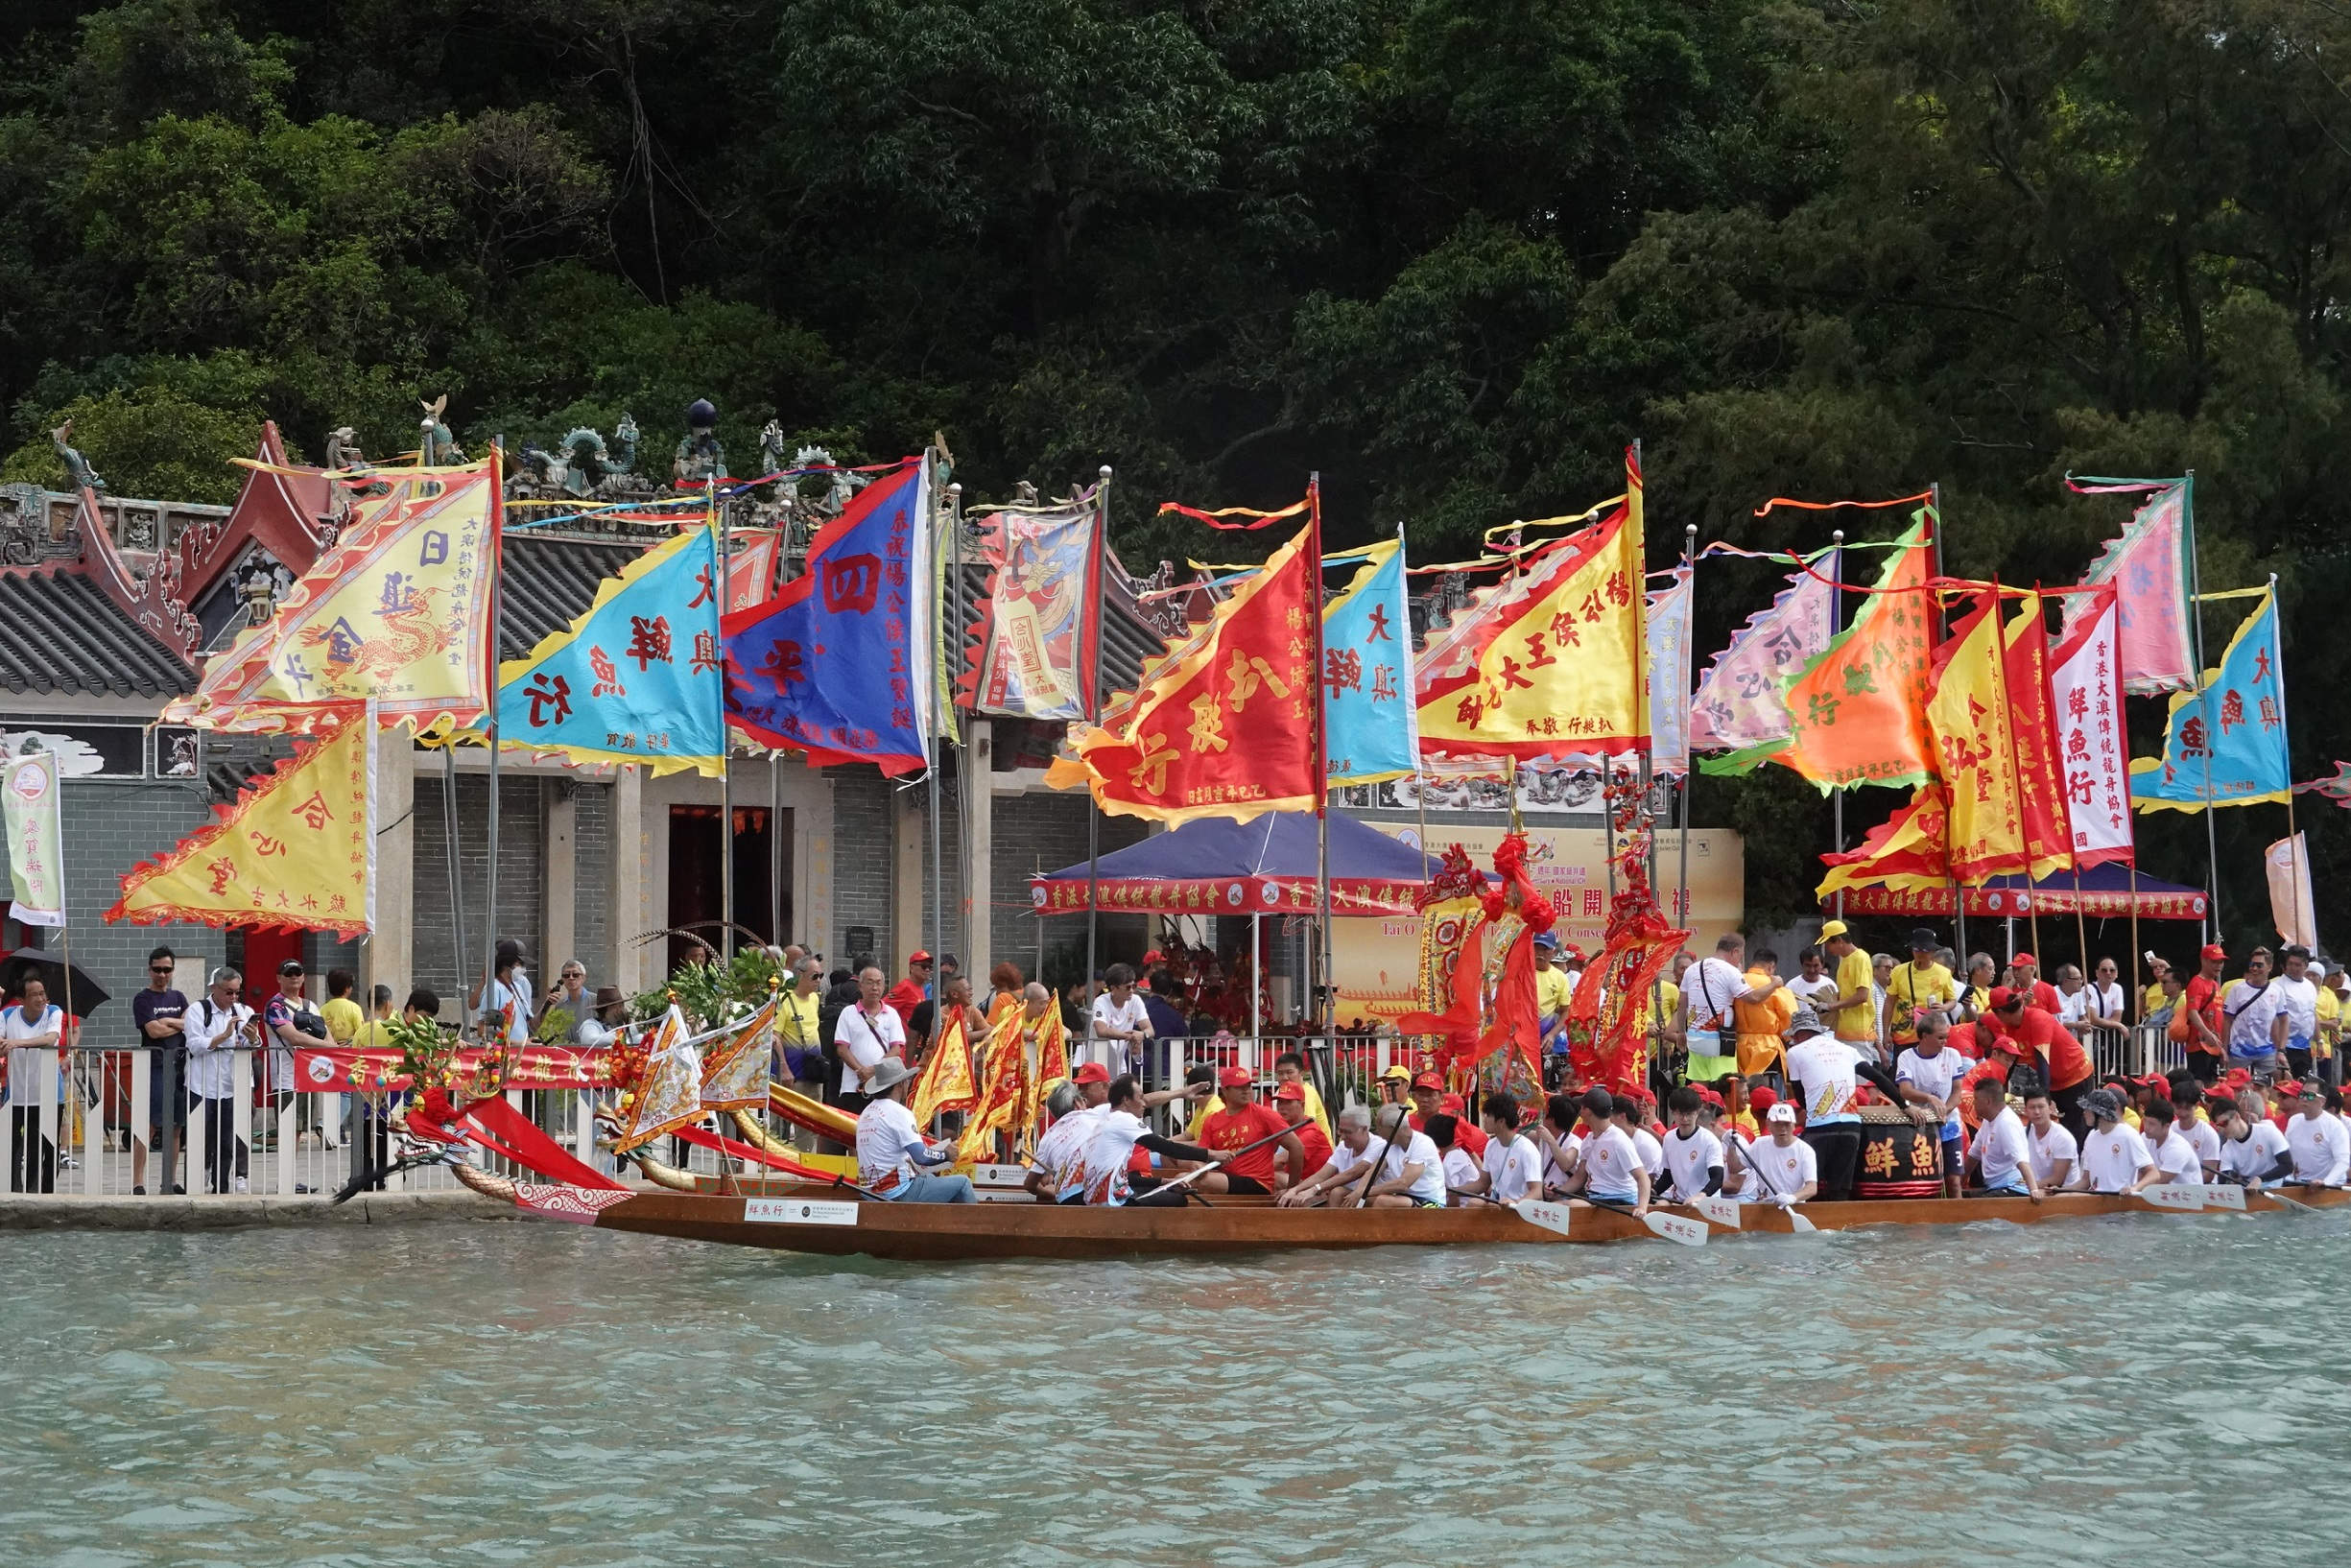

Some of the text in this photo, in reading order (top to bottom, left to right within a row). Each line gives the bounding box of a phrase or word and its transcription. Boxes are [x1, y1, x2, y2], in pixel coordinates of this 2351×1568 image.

[2066, 686, 2096, 806] 鮮魚行
[2096, 640, 2123, 829] 香港大澳傳統龍舟協會
